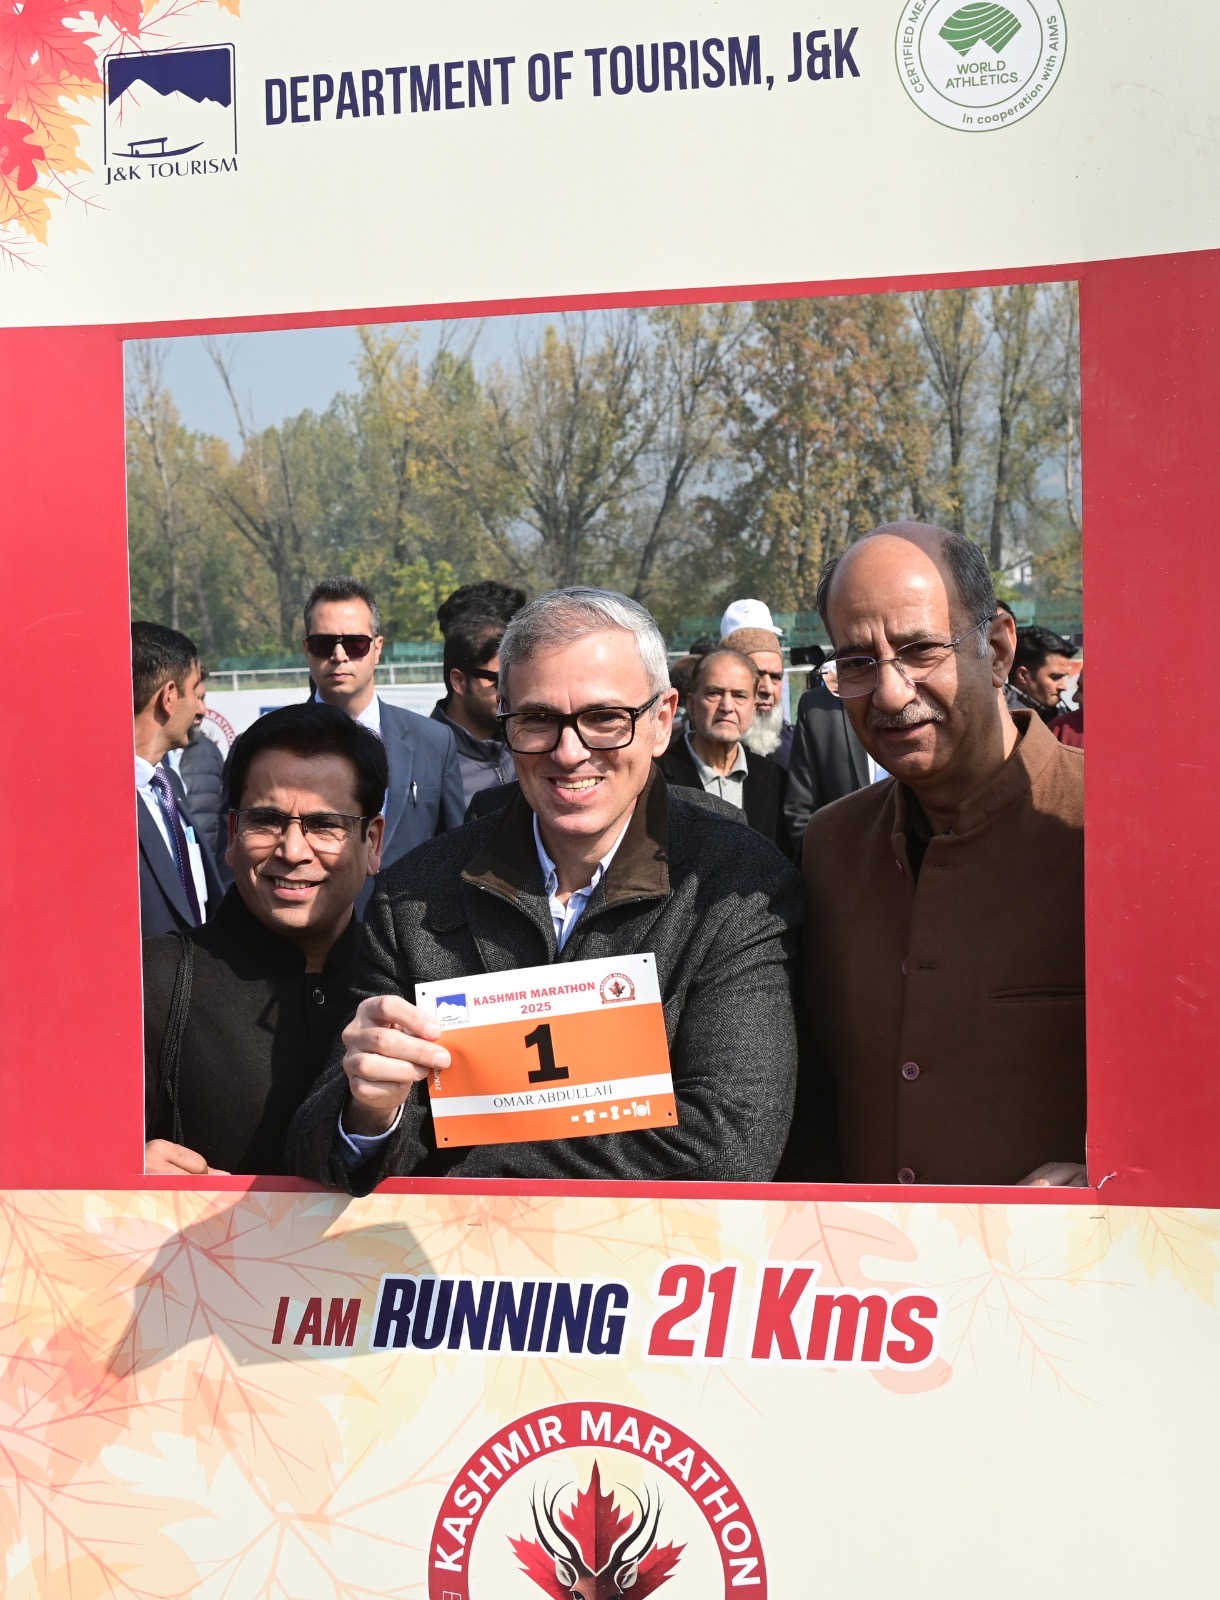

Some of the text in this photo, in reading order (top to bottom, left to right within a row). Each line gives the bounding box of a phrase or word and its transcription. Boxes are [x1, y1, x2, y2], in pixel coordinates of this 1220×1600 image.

[264, 26, 861, 126] DEPARTMENT OF TOURISM, J&K
[903, 26, 925, 93] CERTIFIED
[945, 72, 1019, 89] ATHLETICS
[956, 61, 1006, 75] WORLD
[962, 15, 1059, 124] In cooperation with AIMS
[105, 156, 238, 186] J&K TOURISM
[474, 982, 596, 1006] KASHMIR MARATHON
[520, 1001, 552, 1015] 2025
[524, 1023, 569, 1084] 1
[493, 1084, 613, 1108] OMAR ABDULLAH
[271, 1264, 938, 1364] I AM RUNNING 21 Kms
[434, 1410, 761, 1587] KASHMIR MARATHON
